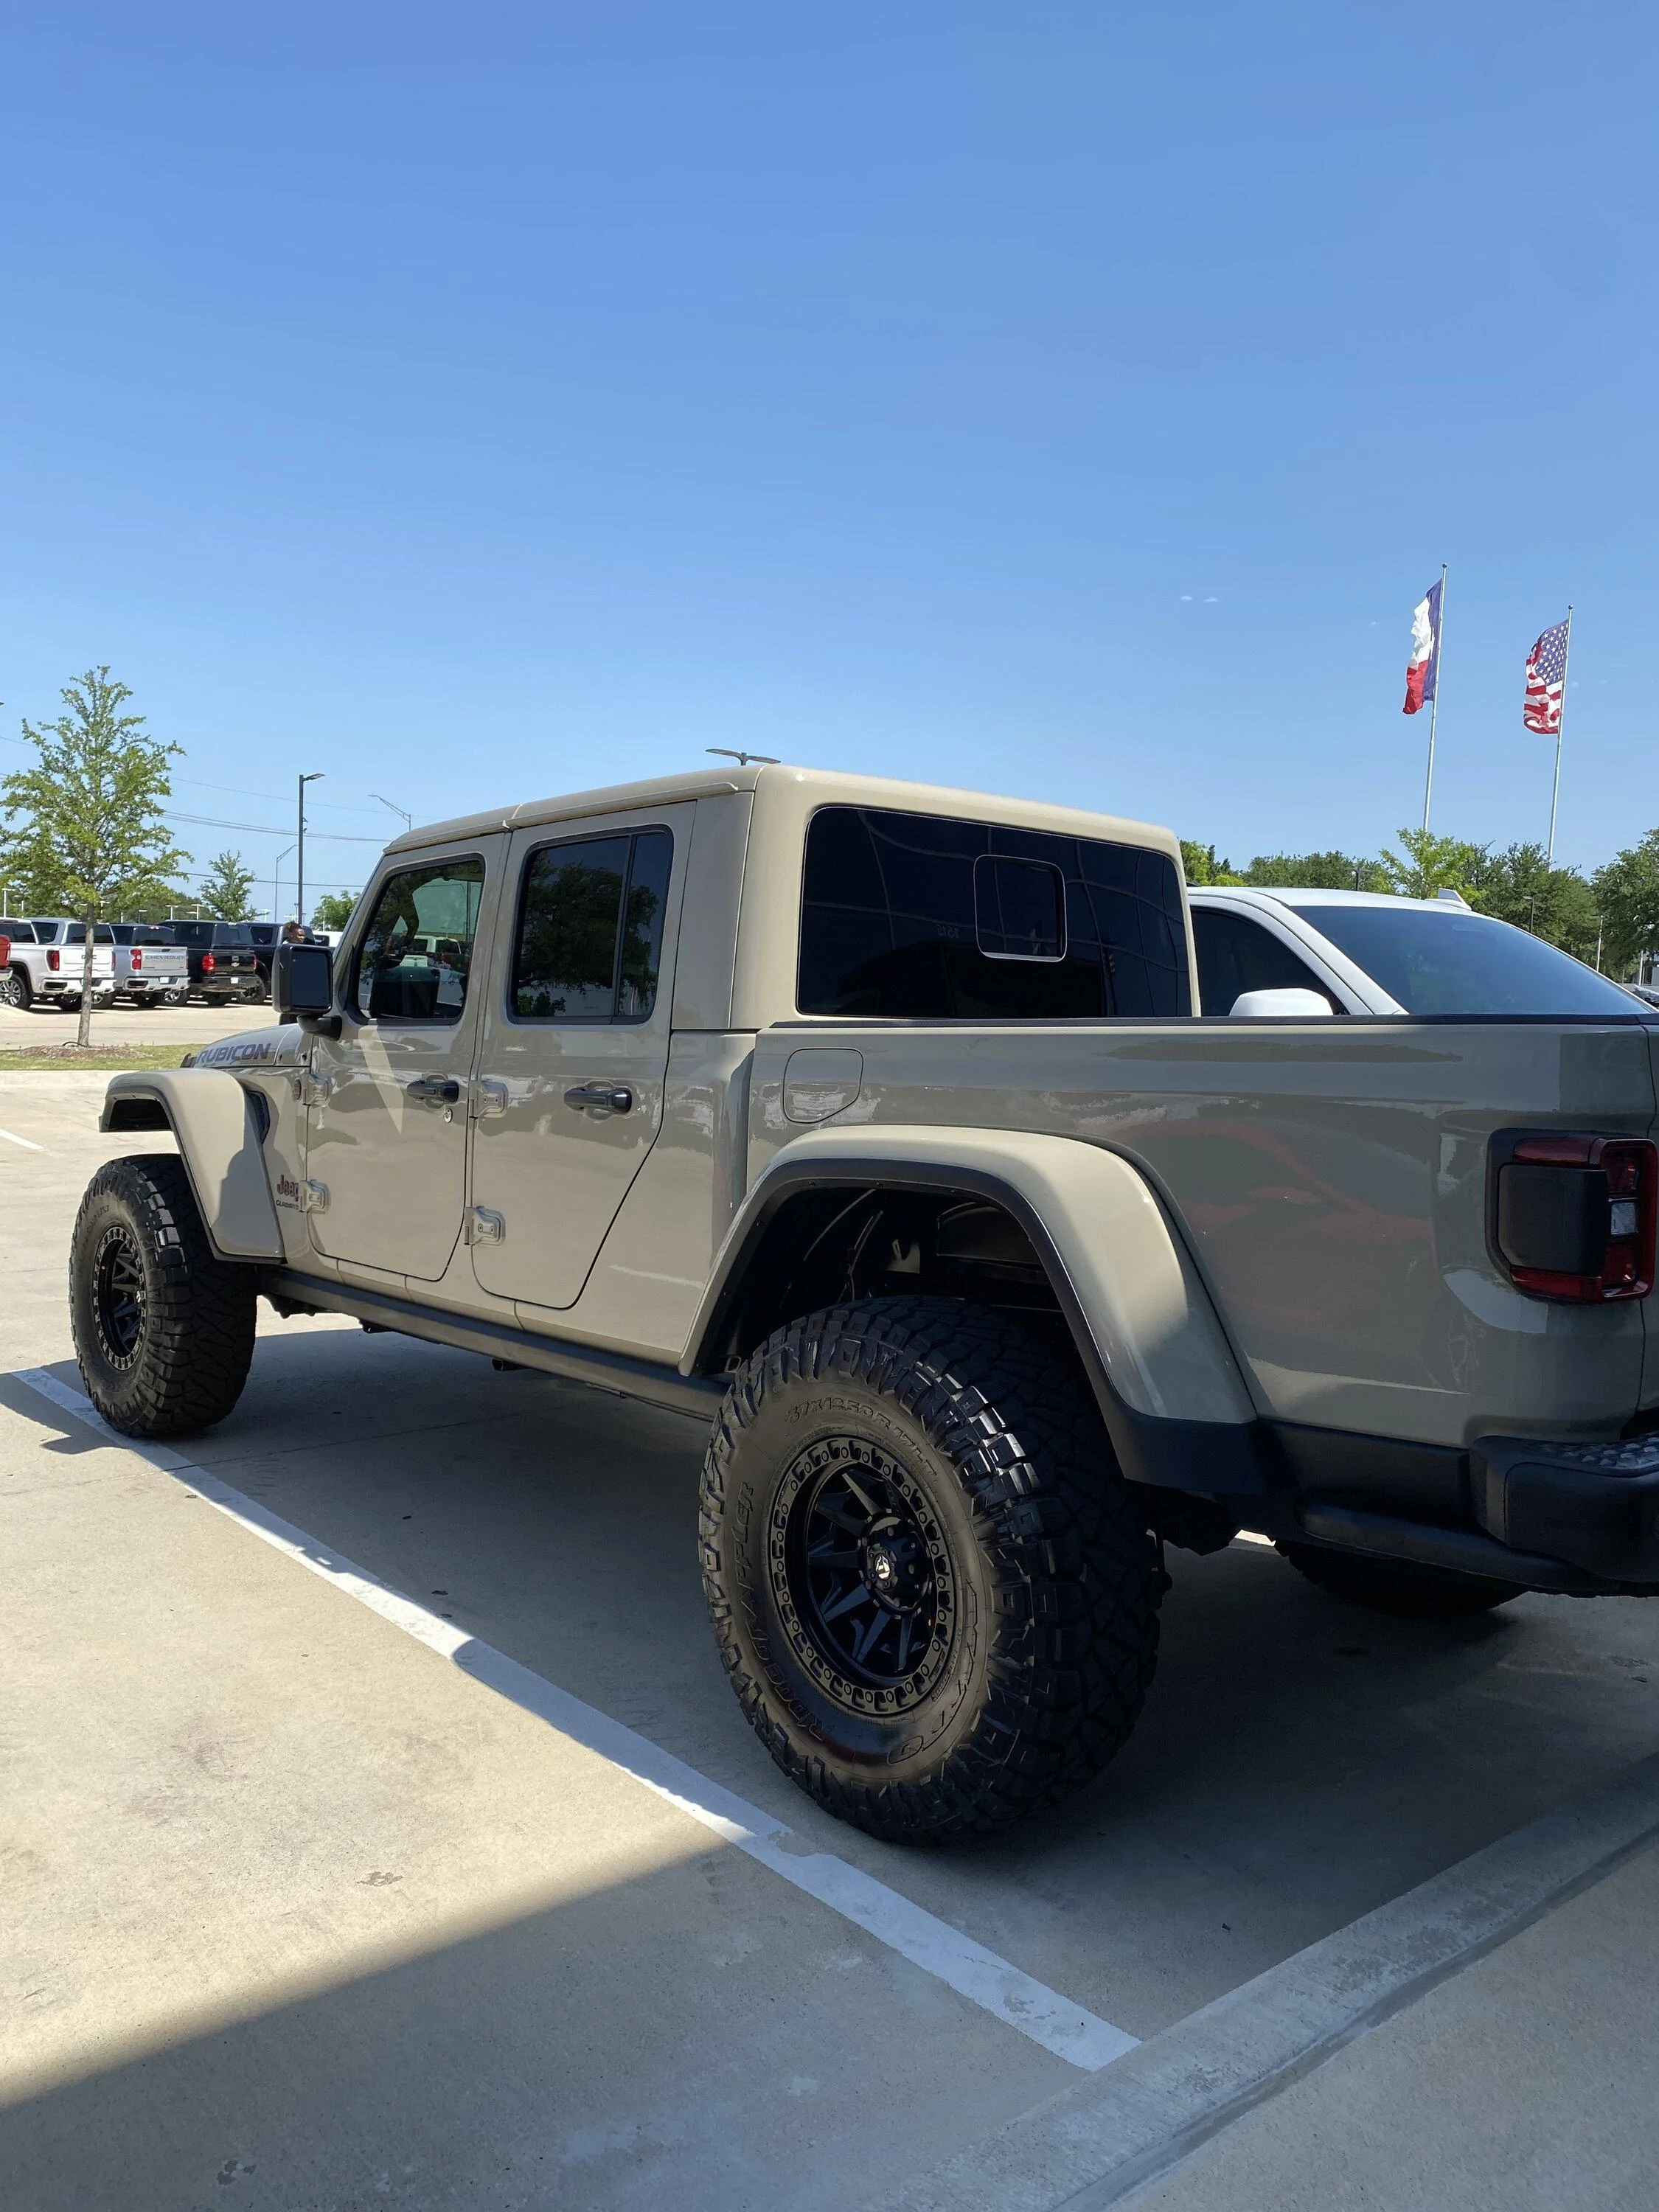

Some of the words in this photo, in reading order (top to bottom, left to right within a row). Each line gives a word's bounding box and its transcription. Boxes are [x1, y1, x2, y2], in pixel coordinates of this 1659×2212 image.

[196, 1043, 272, 1064] RUBICON
[275, 1200, 299, 1210] GLADIATO
[731, 1481, 773, 1661] GRAPPLER
